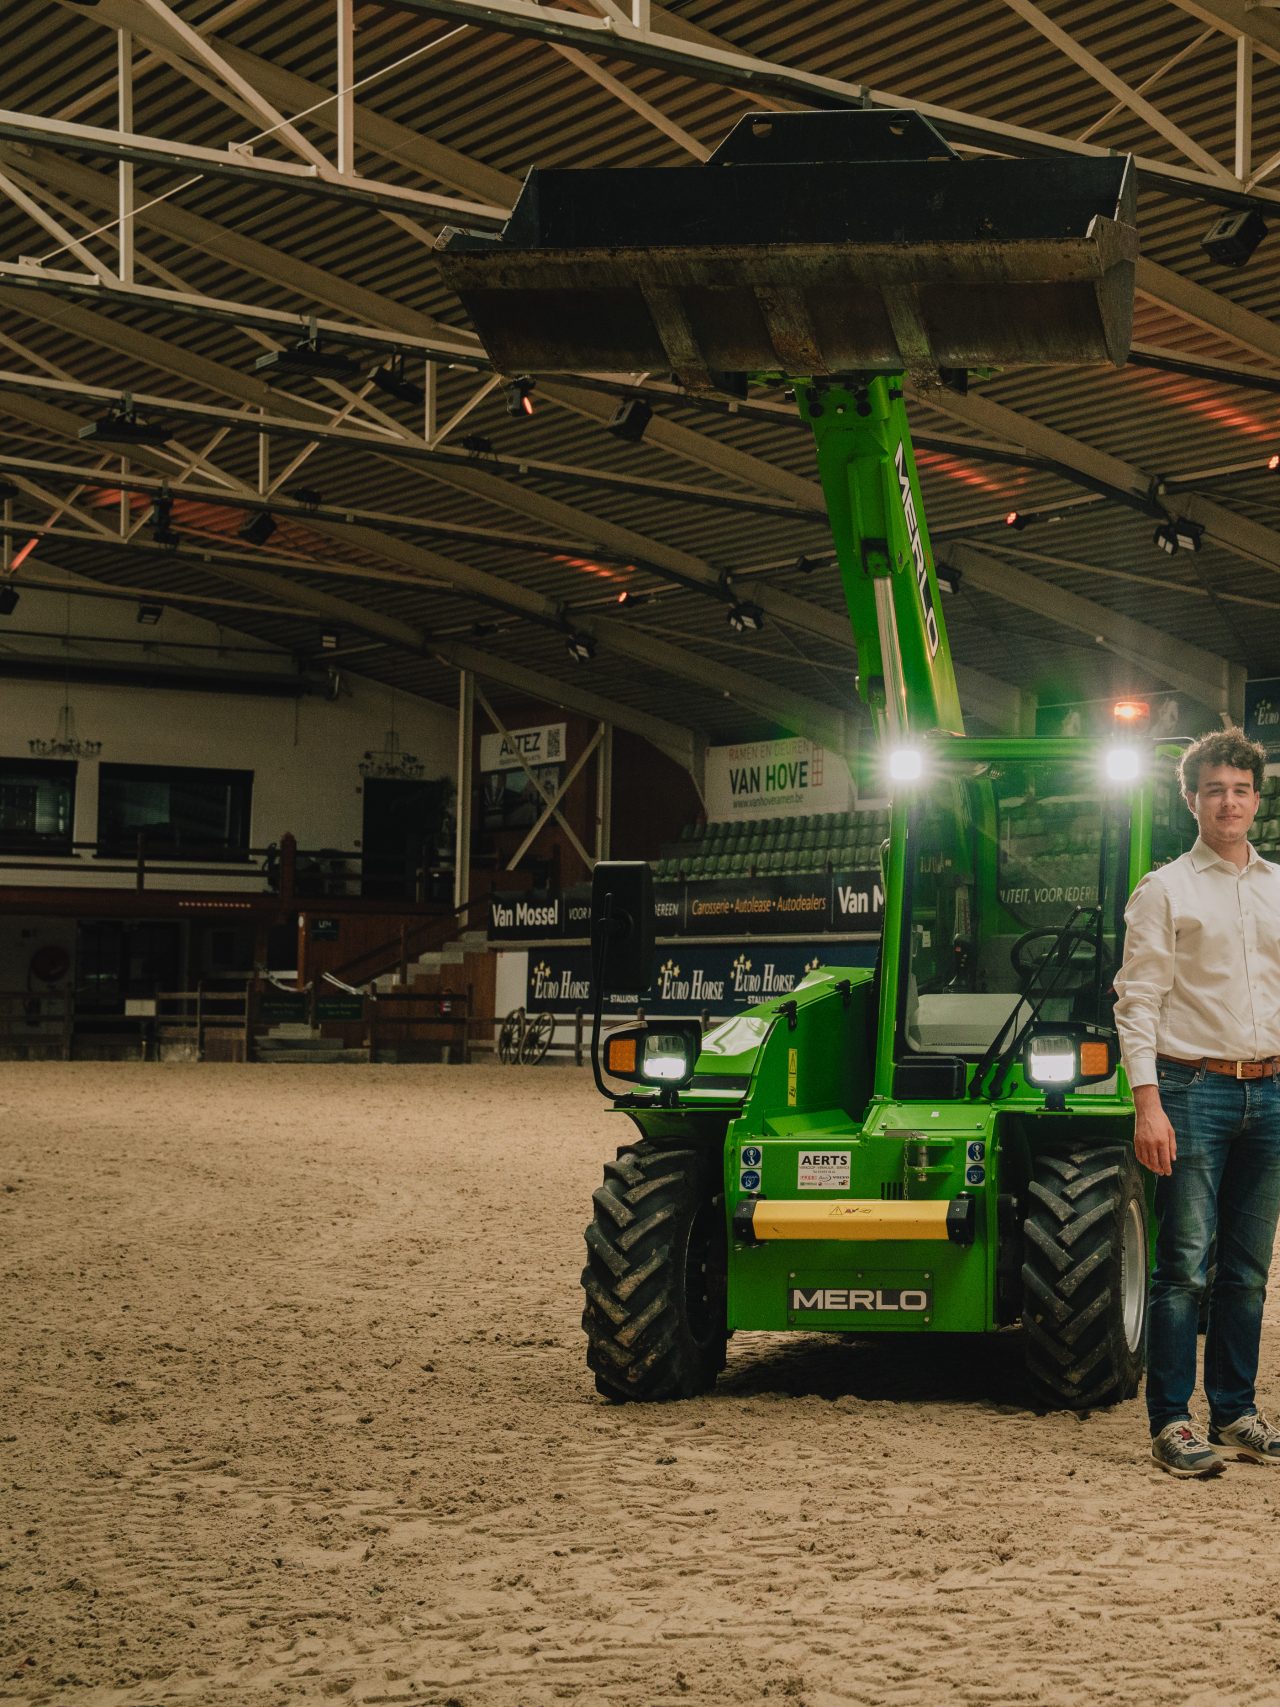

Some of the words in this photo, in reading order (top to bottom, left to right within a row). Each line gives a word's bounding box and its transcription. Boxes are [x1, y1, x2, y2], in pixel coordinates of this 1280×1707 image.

[895, 440, 939, 658] MERLO
[1257, 706, 1279, 725] EURO
[729, 747, 757, 761] RAMEN
[761, 746, 771, 759] EN
[729, 766, 760, 794] VAN
[766, 760, 808, 791] HOVE
[692, 898, 729, 915] Carosserie
[734, 896, 770, 913] Autolease
[777, 893, 826, 911] Autodealers
[838, 886, 868, 914] Van
[1000, 889, 1031, 904] LITEIT,
[1034, 887, 1062, 903] VOOR
[492, 904, 513, 927] Van
[516, 899, 558, 926] Mossel
[569, 908, 586, 920] VOOR
[655, 903, 679, 917] EREEN
[535, 971, 559, 999] EURO
[560, 970, 591, 999] HORSE
[662, 970, 689, 1000] EURO
[691, 970, 725, 1000] HORSE
[734, 964, 760, 992] EURO
[762, 964, 795, 992] HORSE
[610, 994, 638, 1003] STALLIONS
[801, 1155, 848, 1165] AERTS
[793, 1289, 927, 1311] MERLO
